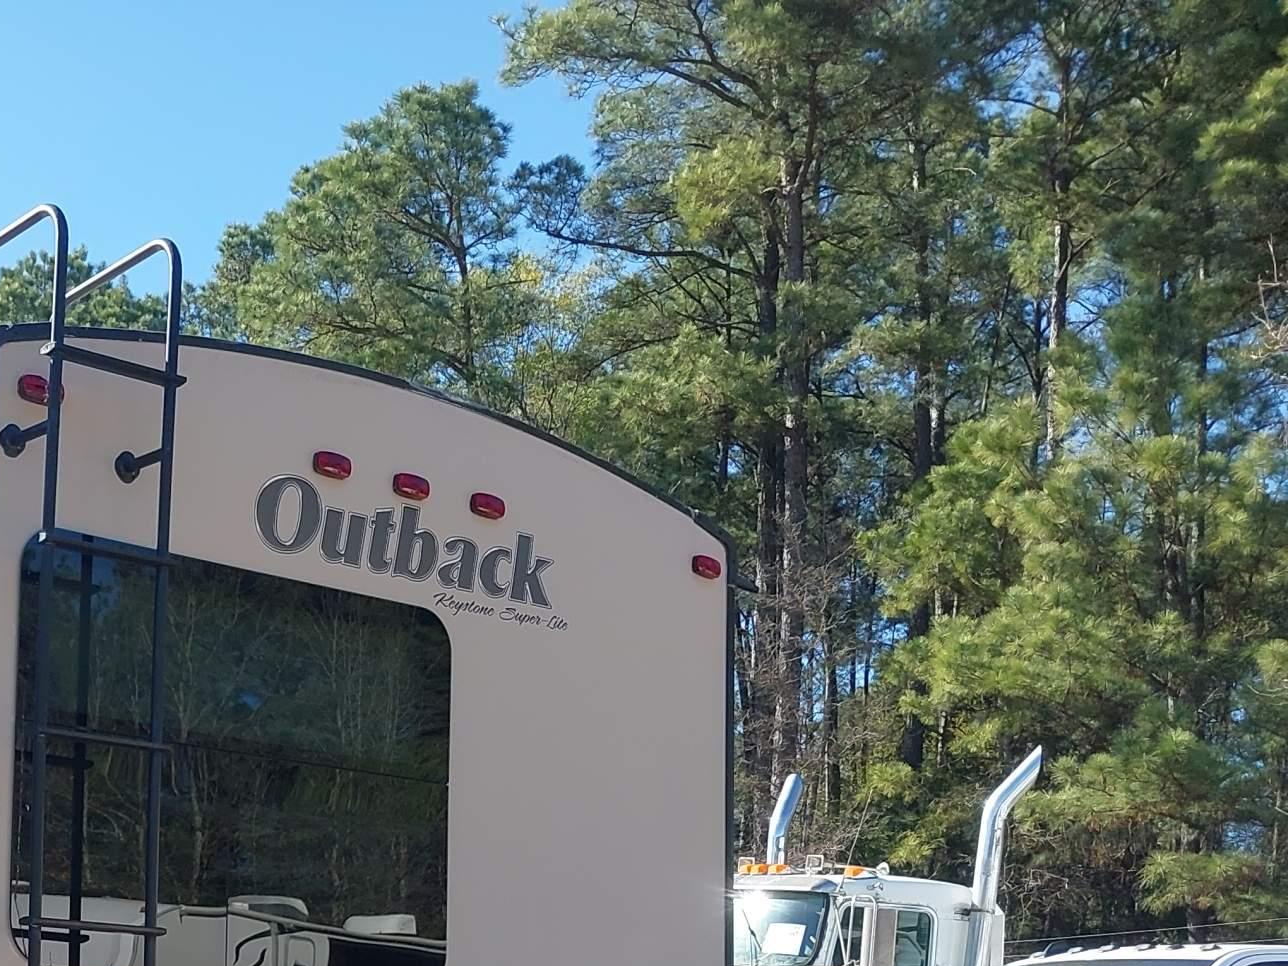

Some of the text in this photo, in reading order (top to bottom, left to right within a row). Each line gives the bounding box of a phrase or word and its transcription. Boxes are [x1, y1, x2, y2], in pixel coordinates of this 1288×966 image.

[254, 473, 554, 610] Outback
[433, 592, 569, 632] Keystone Super-Lite
